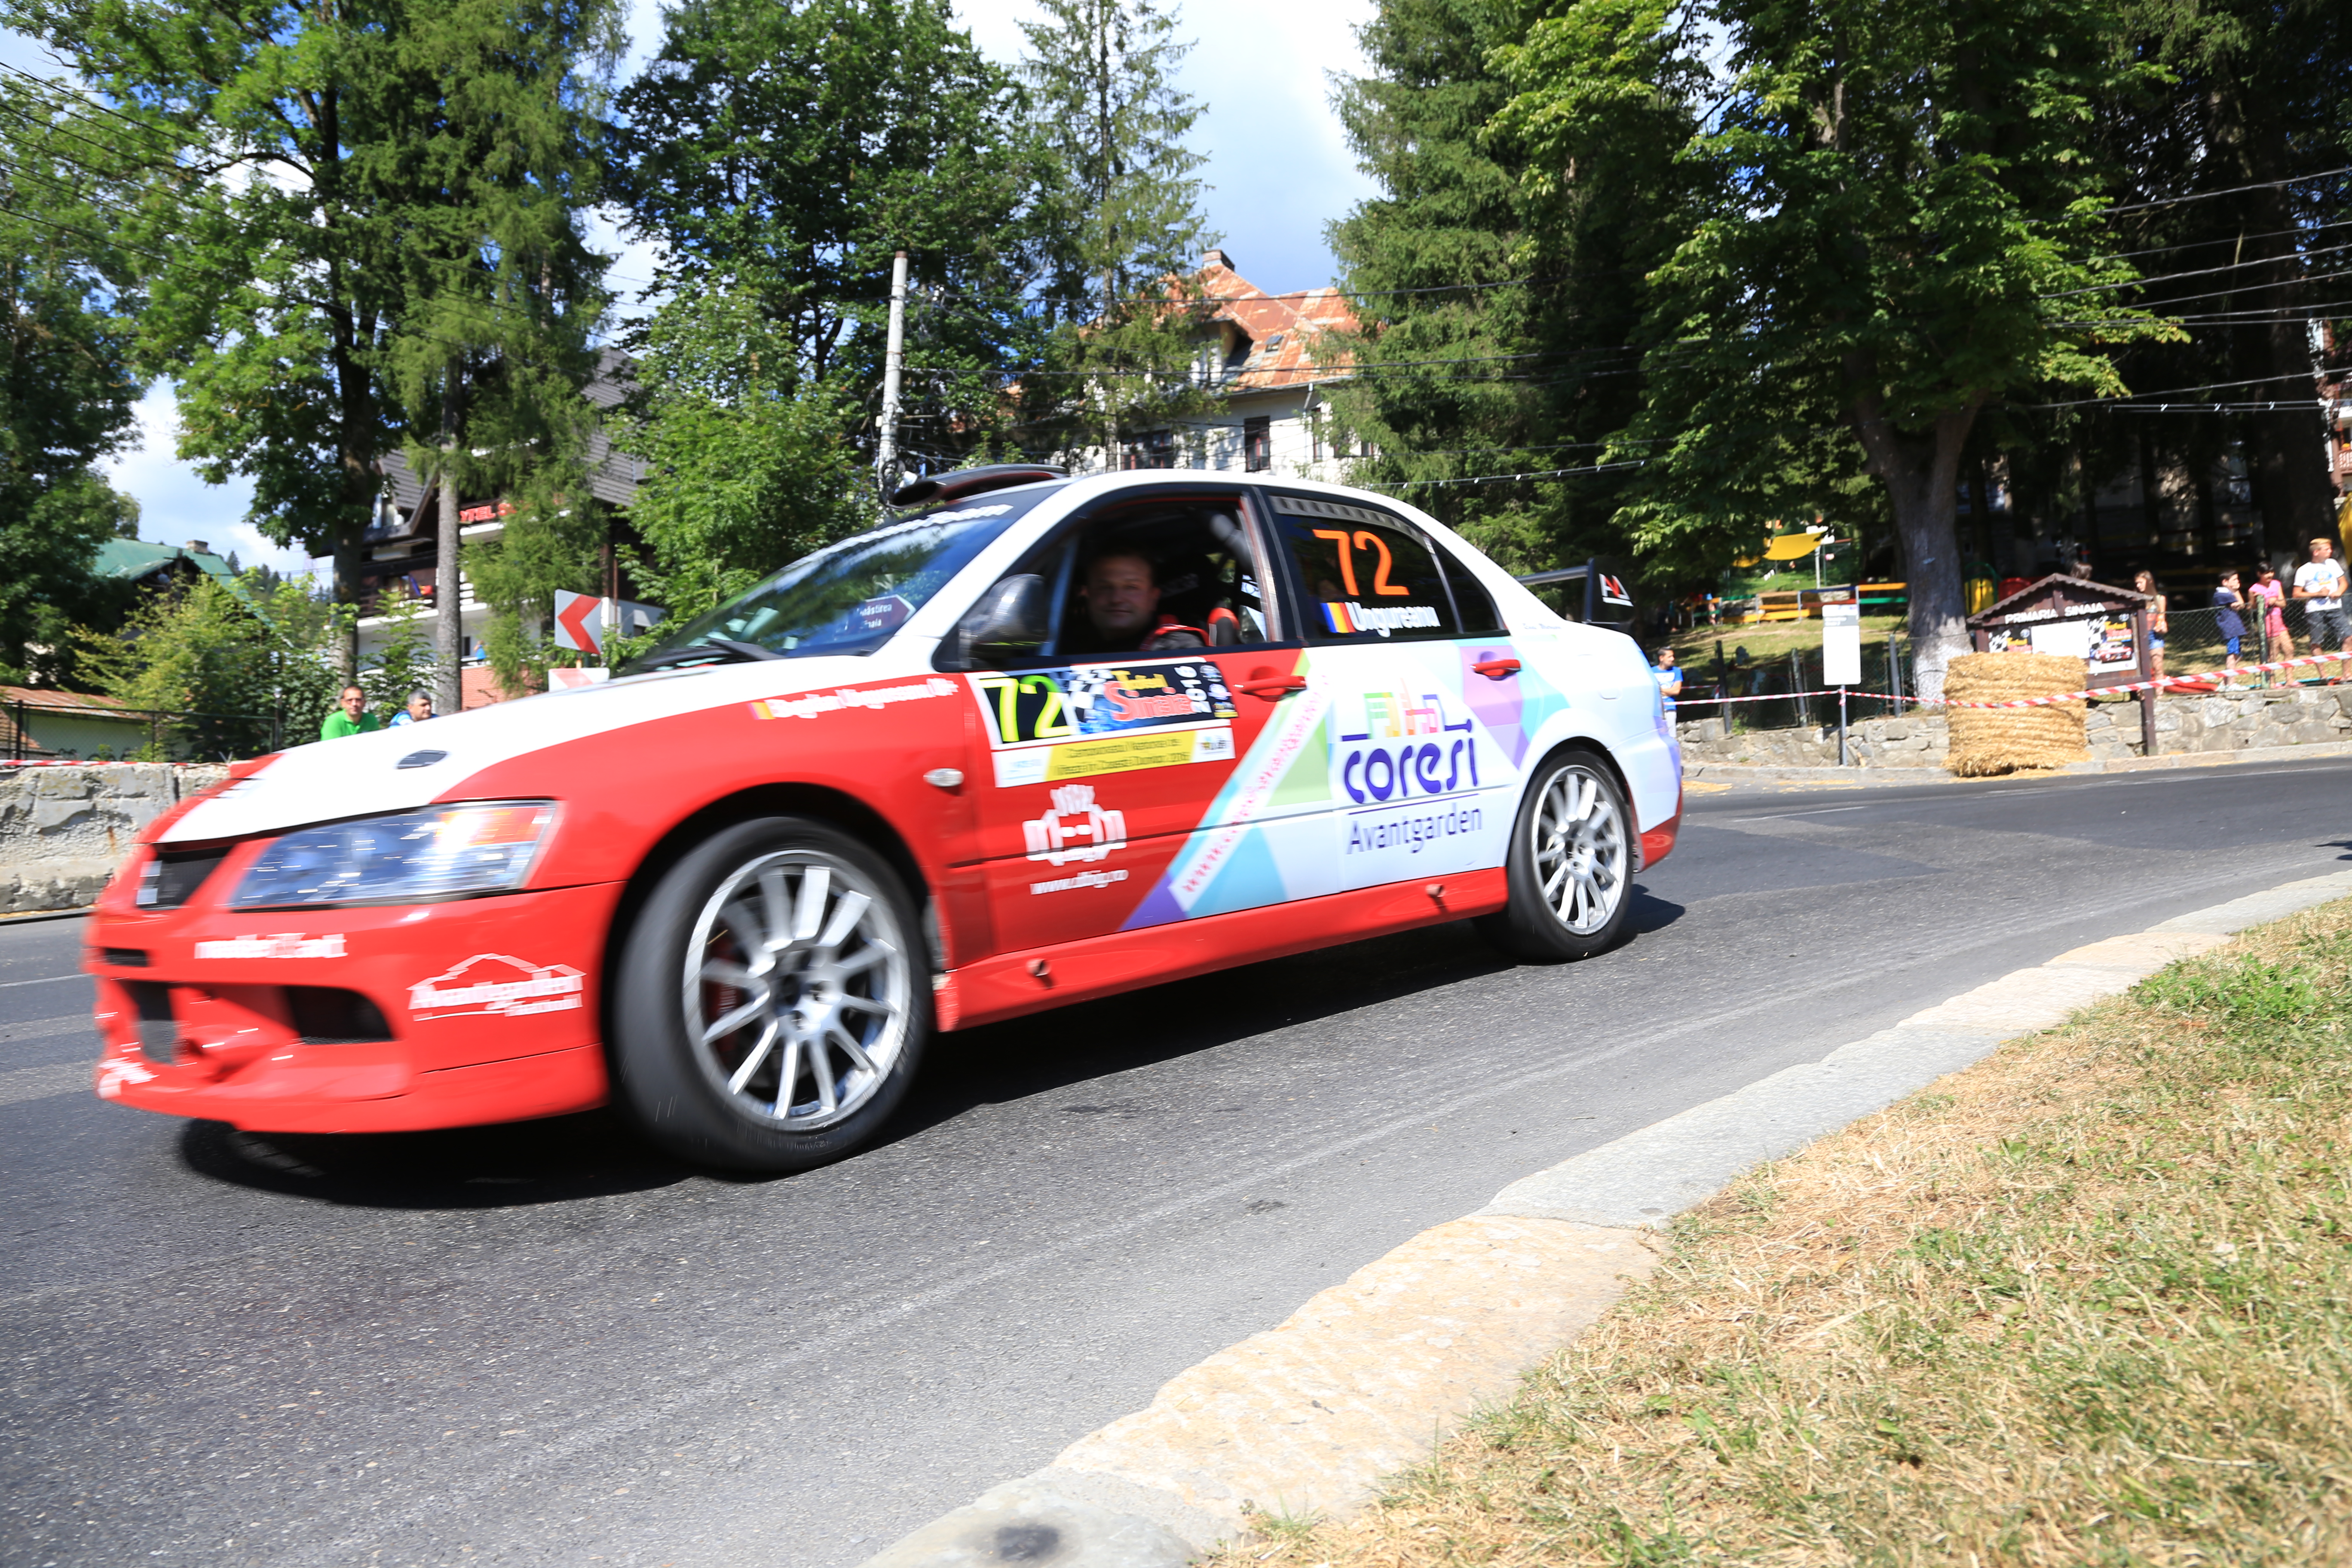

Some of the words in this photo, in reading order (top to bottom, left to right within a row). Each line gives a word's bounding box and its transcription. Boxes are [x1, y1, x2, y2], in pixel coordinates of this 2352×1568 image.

[1312, 529, 1410, 596] 72
[1344, 601, 1441, 638] Ungureanu
[2005, 608, 2059, 625] PRIMARIA
[2064, 602, 2106, 617] SINAIA
[973, 675, 1074, 742] 72
[1346, 801, 1482, 854] Avantgarden
